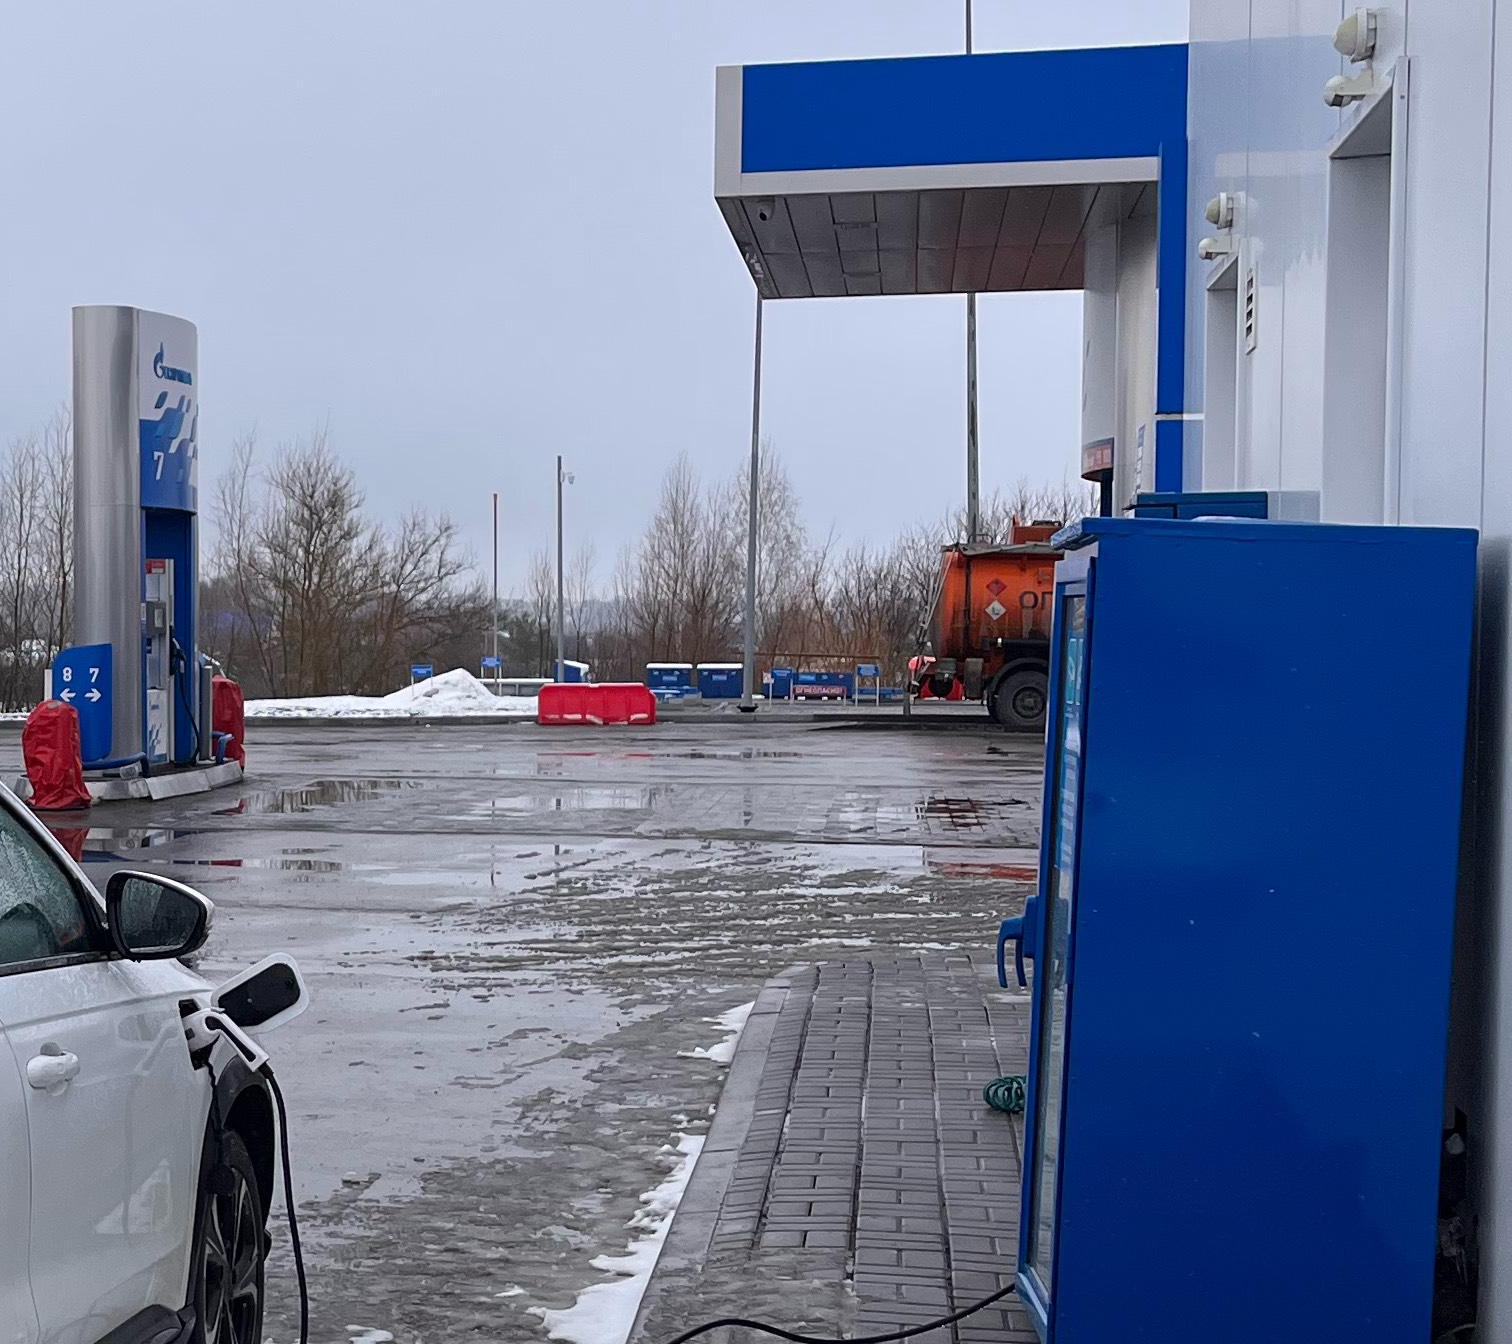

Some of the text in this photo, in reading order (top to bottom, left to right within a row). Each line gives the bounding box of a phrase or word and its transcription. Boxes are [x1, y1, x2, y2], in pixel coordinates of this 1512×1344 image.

[153, 451, 164, 481] 7
[62, 666, 99, 683] 8 7
